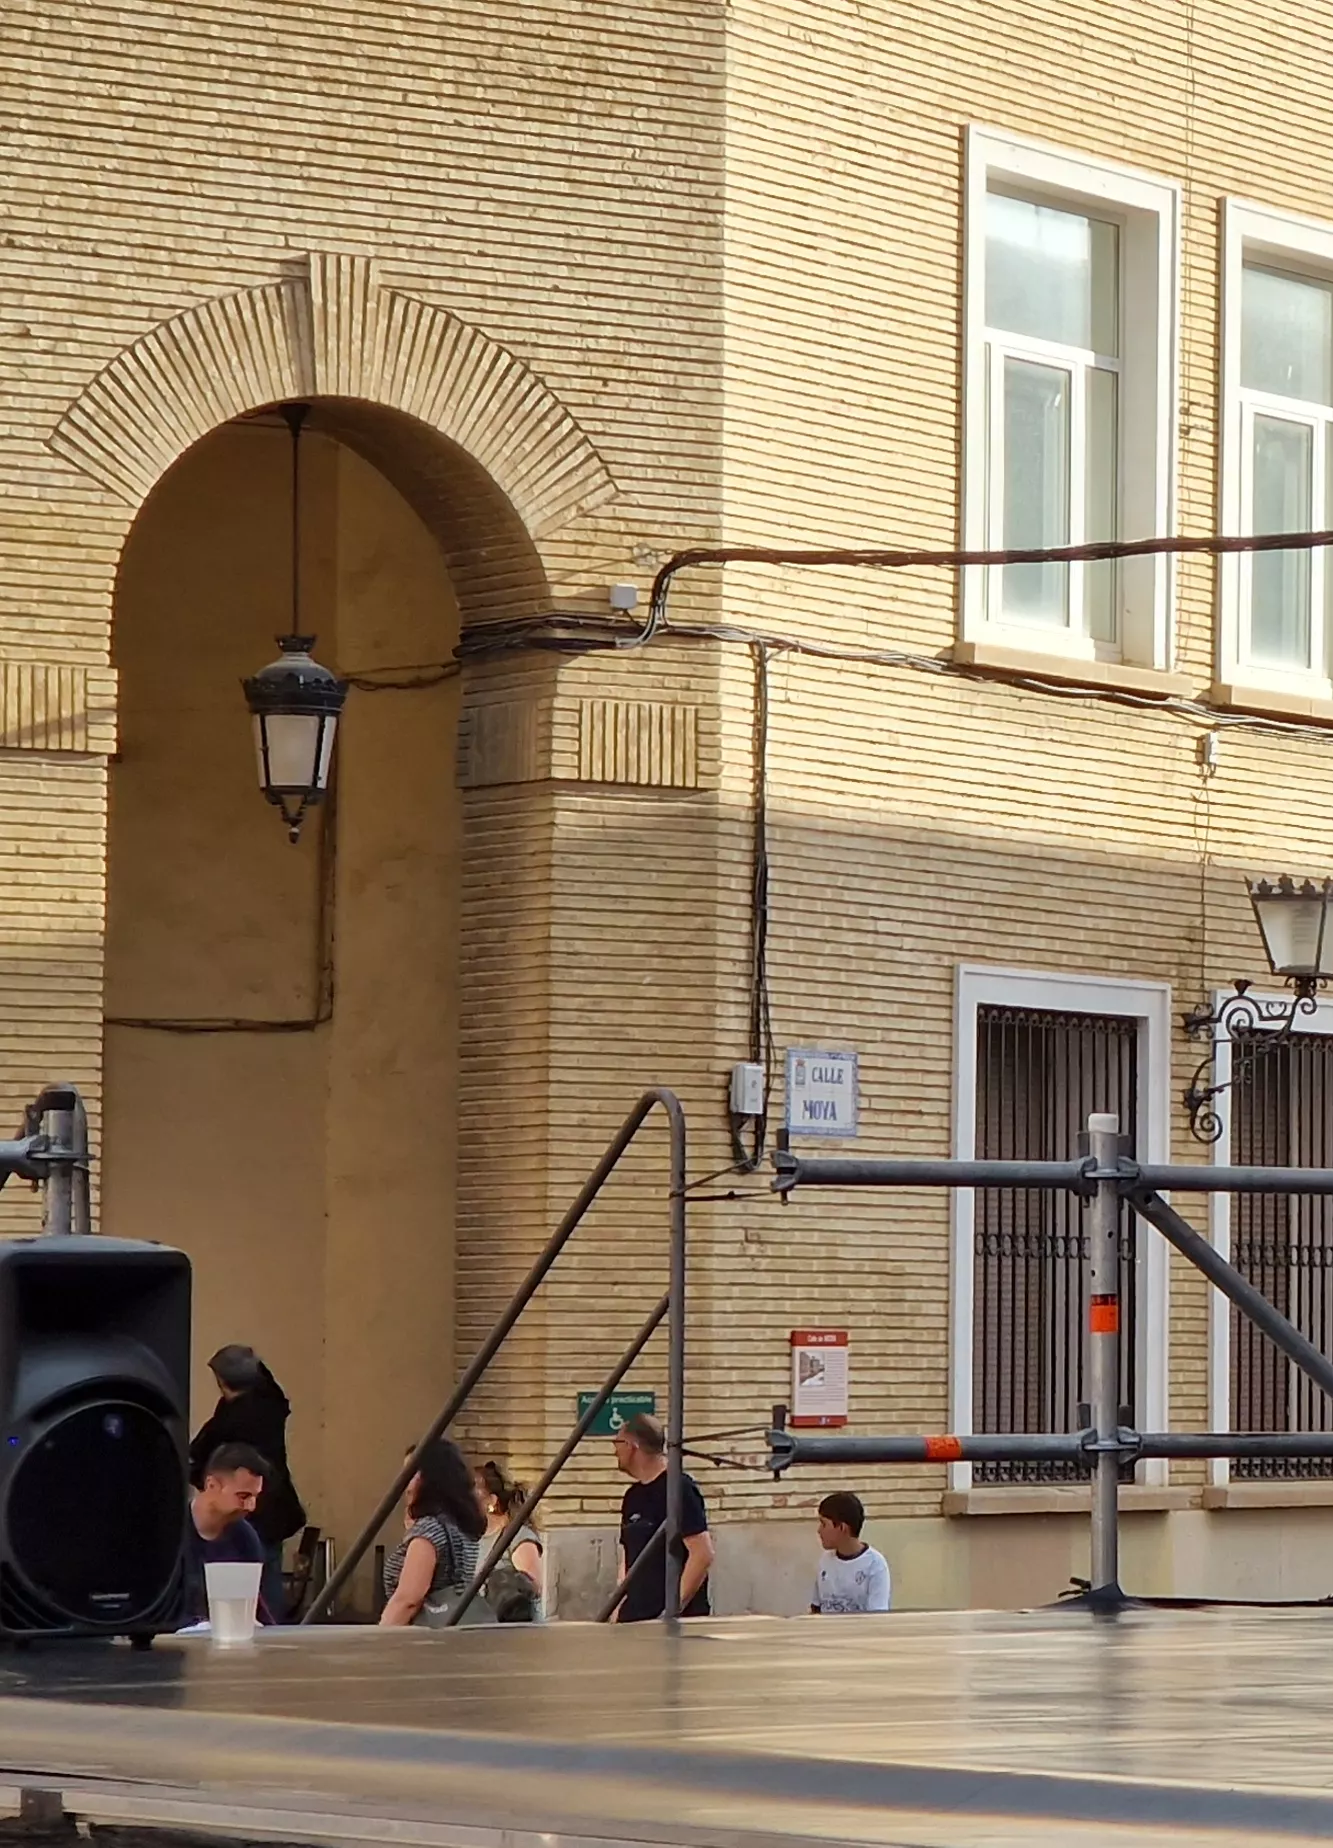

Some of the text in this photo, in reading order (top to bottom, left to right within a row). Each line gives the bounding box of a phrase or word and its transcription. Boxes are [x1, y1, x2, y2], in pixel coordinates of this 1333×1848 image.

[811, 1066, 844, 1085] CALLE
[802, 1100, 837, 1121] MOYA
[611, 1395, 652, 1404] practicable
